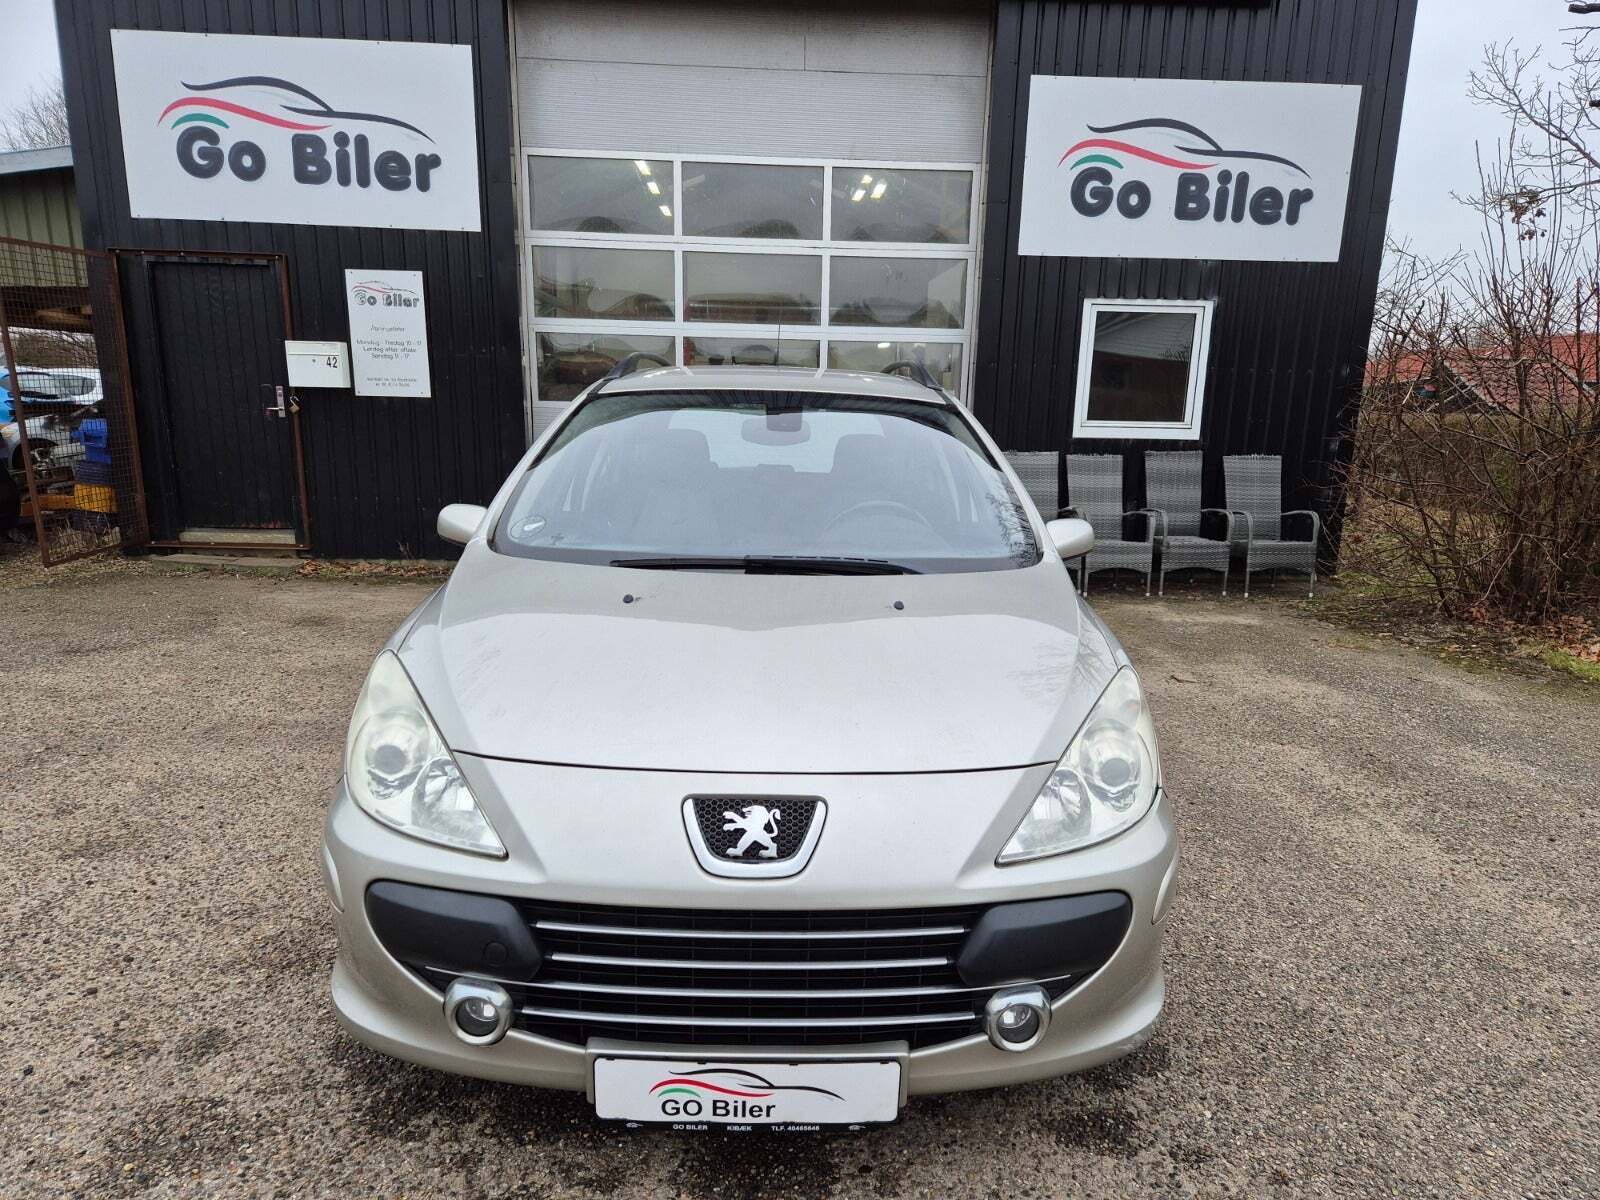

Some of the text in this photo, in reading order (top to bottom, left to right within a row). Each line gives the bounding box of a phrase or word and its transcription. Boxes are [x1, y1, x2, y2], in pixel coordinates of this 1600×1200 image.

[176, 124, 441, 192] Go Biler
[1070, 166, 1314, 226] Go Biler
[354, 292, 419, 308] Go Biler
[326, 356, 338, 369] 42
[661, 1099, 776, 1118] GO Biler
[686, 1123, 708, 1131] BILER
